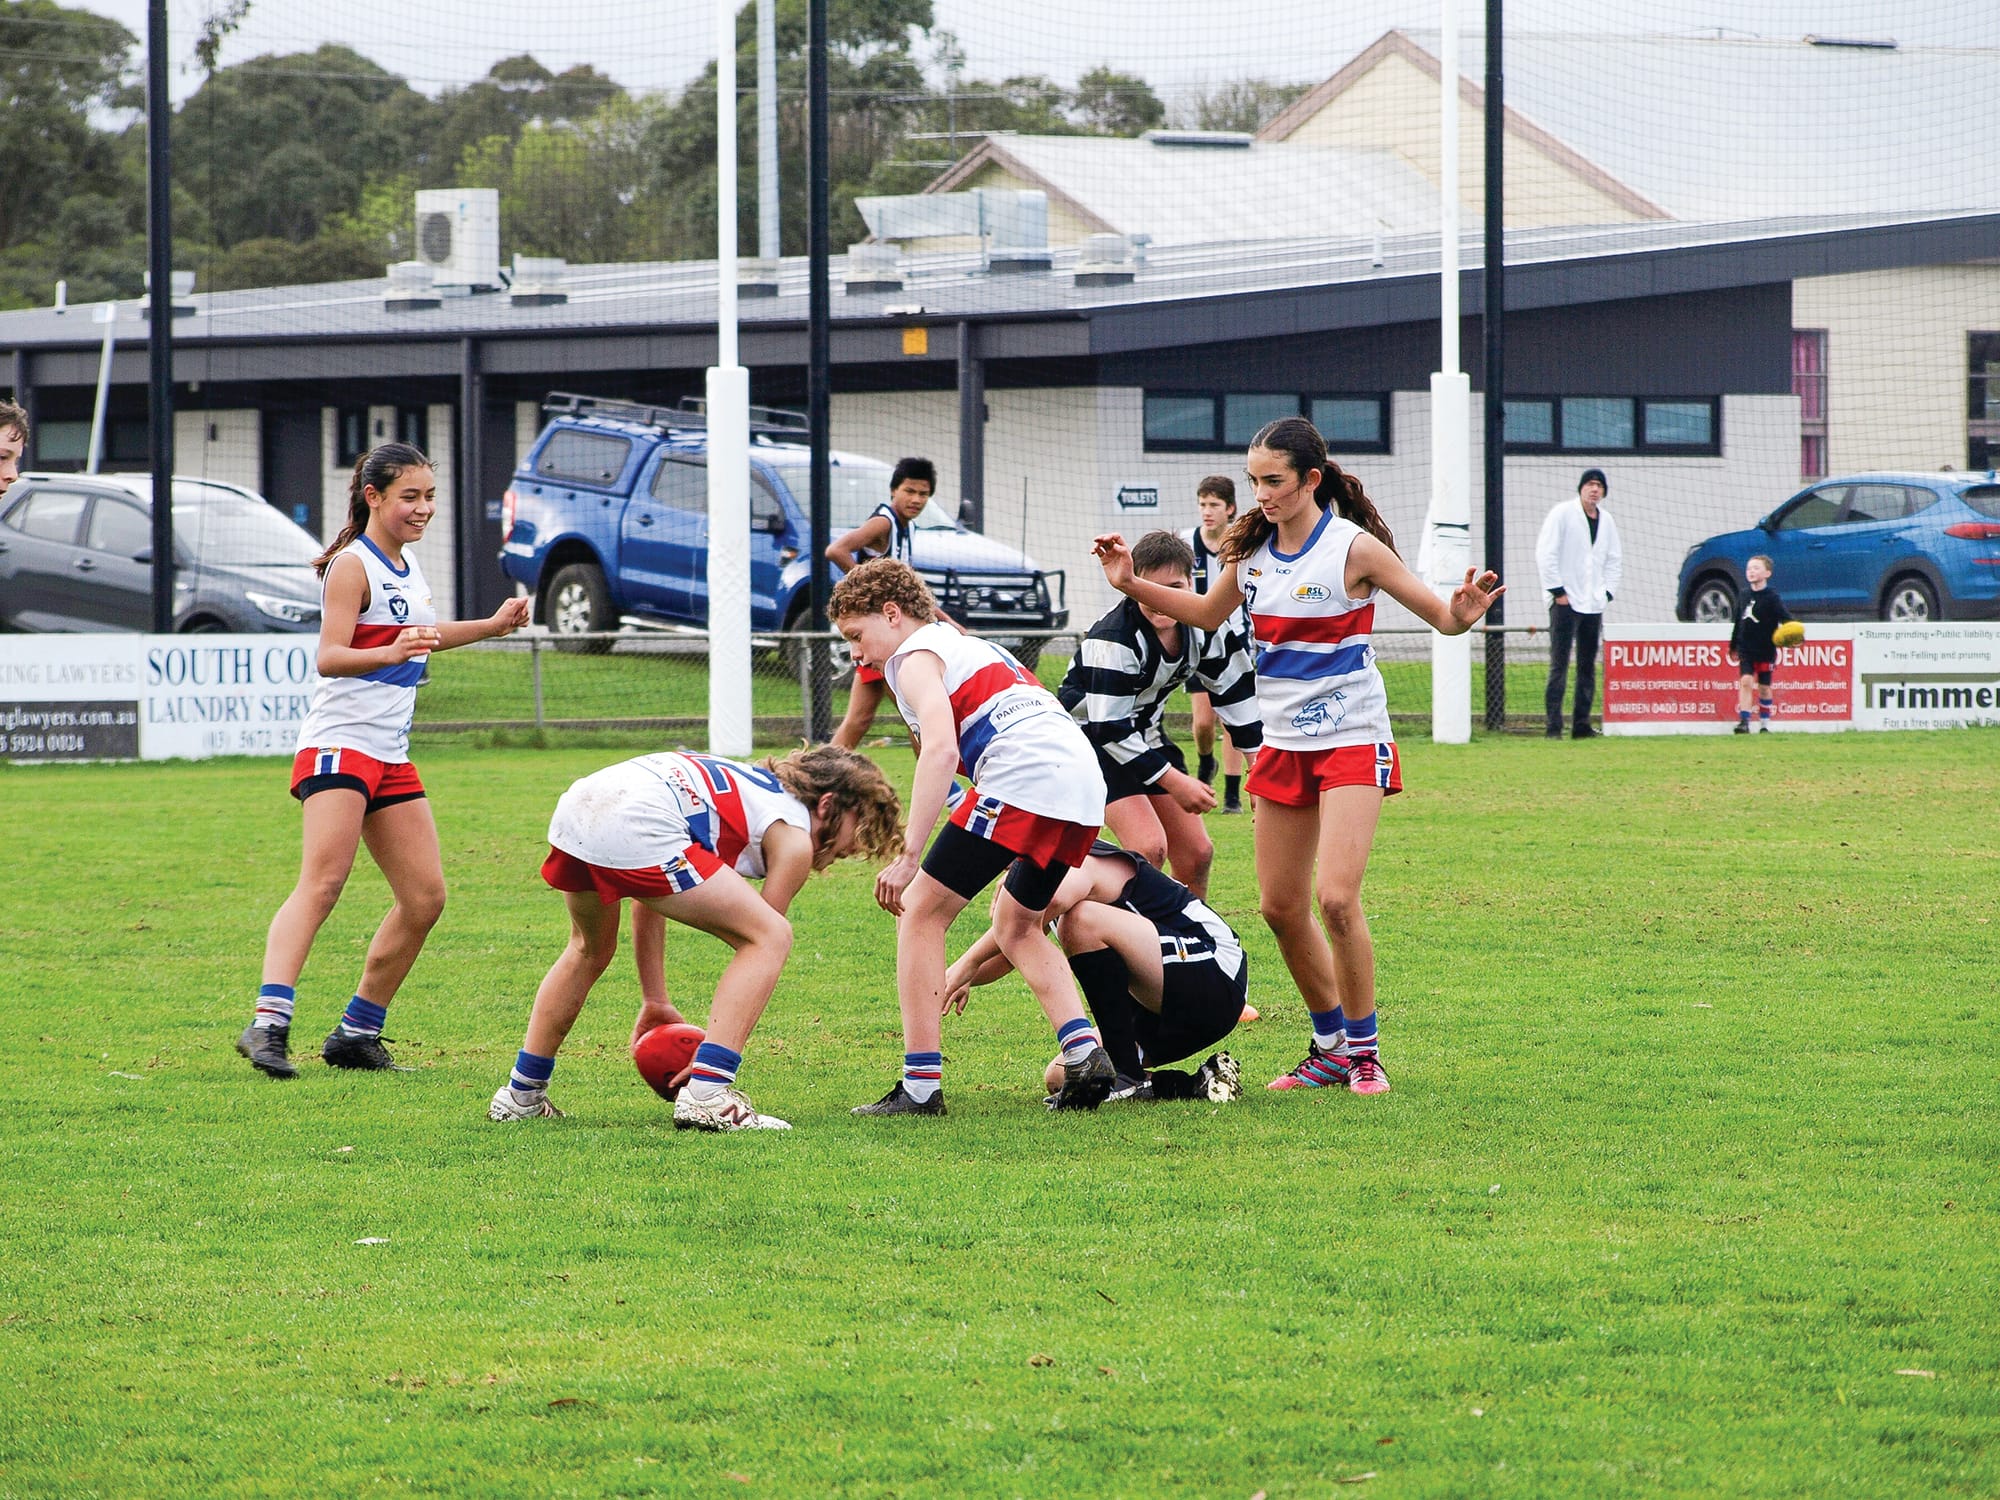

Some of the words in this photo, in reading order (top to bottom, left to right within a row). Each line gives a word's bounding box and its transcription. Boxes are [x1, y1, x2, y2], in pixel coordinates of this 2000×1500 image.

[1121, 491, 1156, 504] TOILETS
[1306, 586, 1323, 595] RSL
[1895, 630, 1929, 641] grinding
[1936, 629, 1961, 639] Public
[1964, 629, 1993, 640] liability
[1610, 645, 1722, 668] PLUMMERS
[1725, 645, 1847, 668] GDENING
[1890, 650, 1908, 659] Tree
[1911, 650, 1938, 662] Felling
[1941, 650, 1957, 660] and
[1959, 650, 1991, 662] pruning
[147, 648, 252, 686] SOUTH
[46, 663, 137, 684] LAWYERS
[1621, 680, 1646, 690] YEARS
[1647, 680, 1699, 690] EXPERIENCE
[1770, 680, 1814, 690] orticultural
[148, 695, 255, 723] LAUNDRY
[1609, 702, 1650, 714] WARREN
[1779, 702, 1806, 714] Coast
[1807, 703, 1819, 714] to
[1819, 702, 1847, 714] Coast
